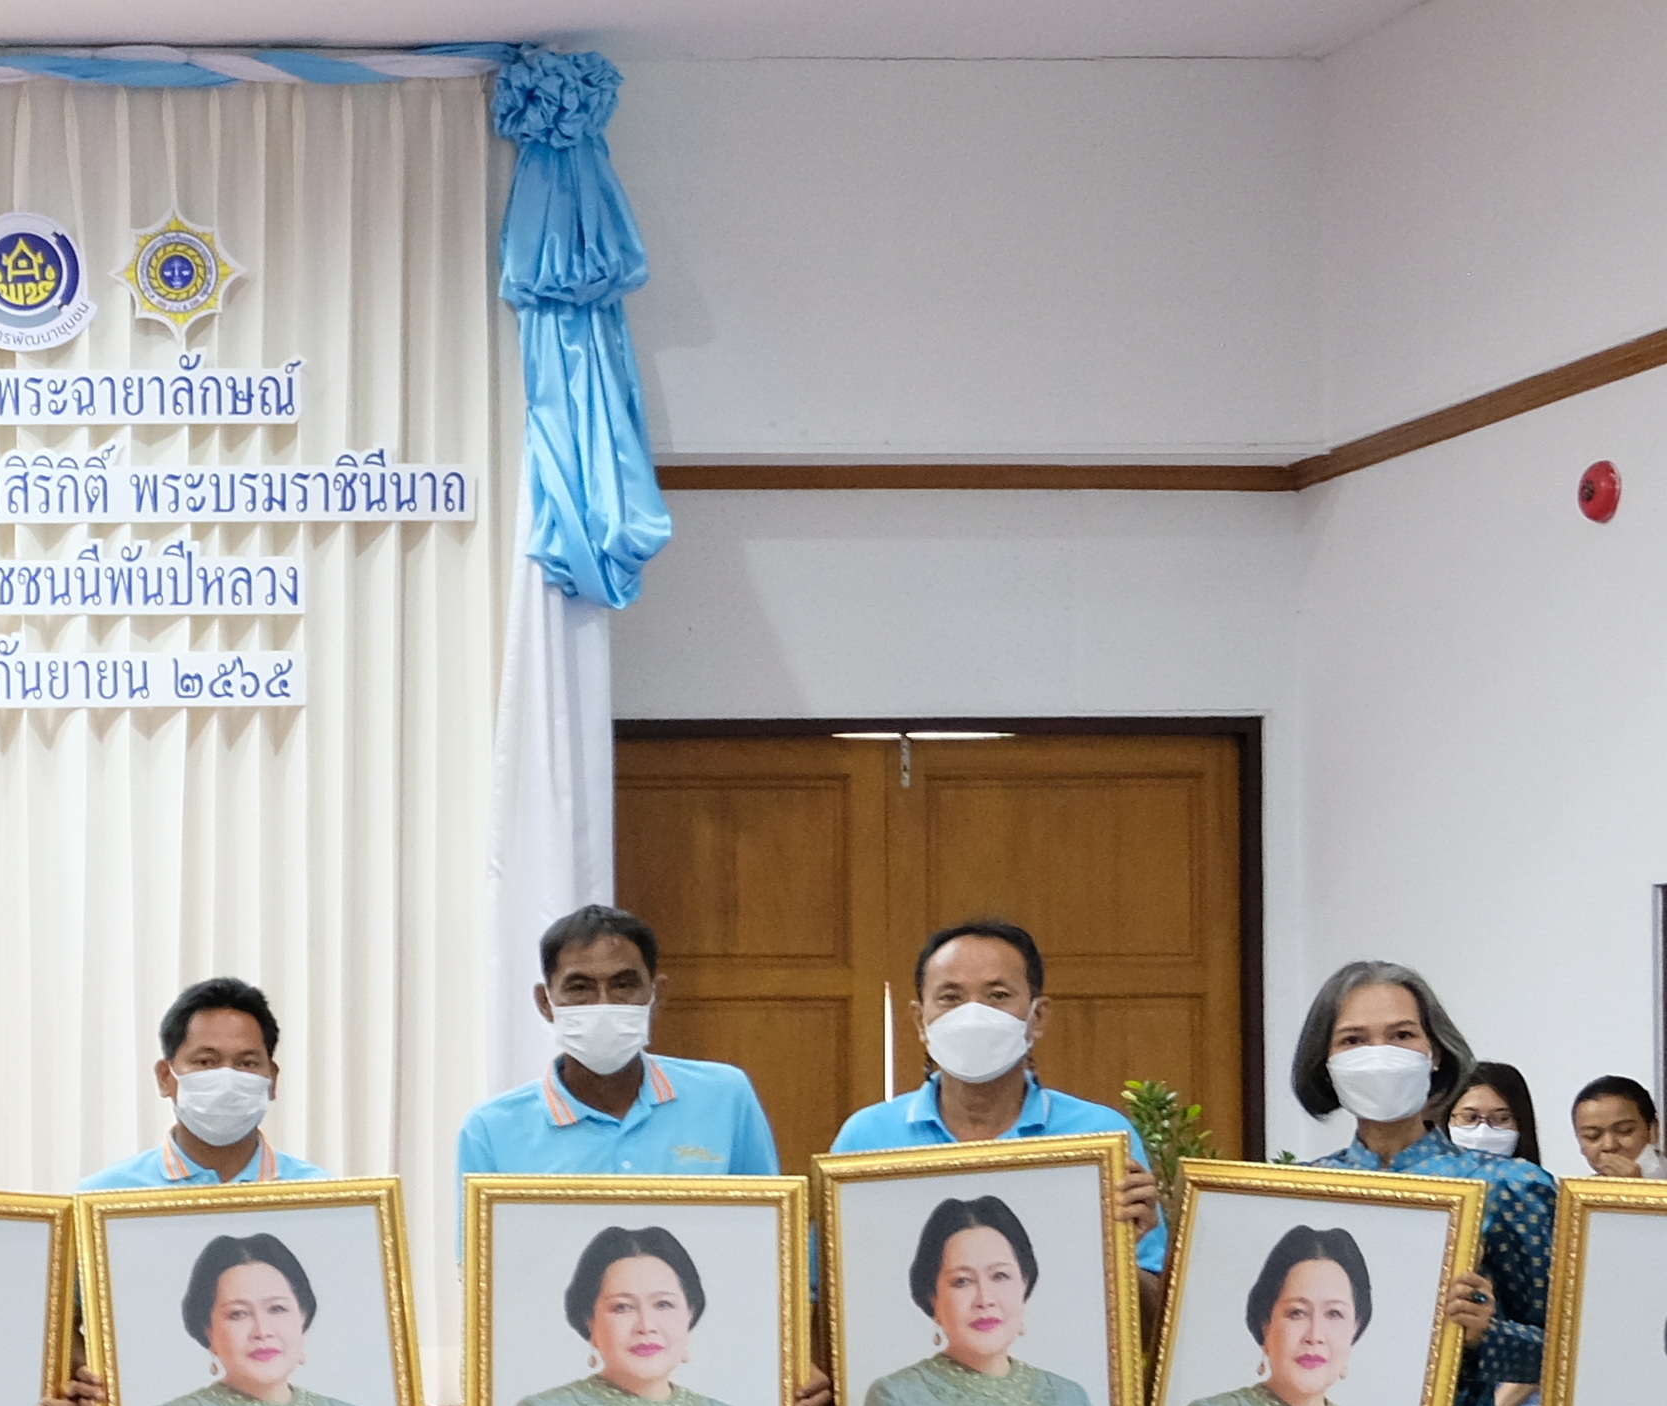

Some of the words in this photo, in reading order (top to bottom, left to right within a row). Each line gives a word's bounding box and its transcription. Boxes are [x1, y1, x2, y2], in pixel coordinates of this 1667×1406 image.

[130, 449, 466, 513] พระบรมราชินีนาถ
[172, 656, 294, 699] ๒๕๖๕
